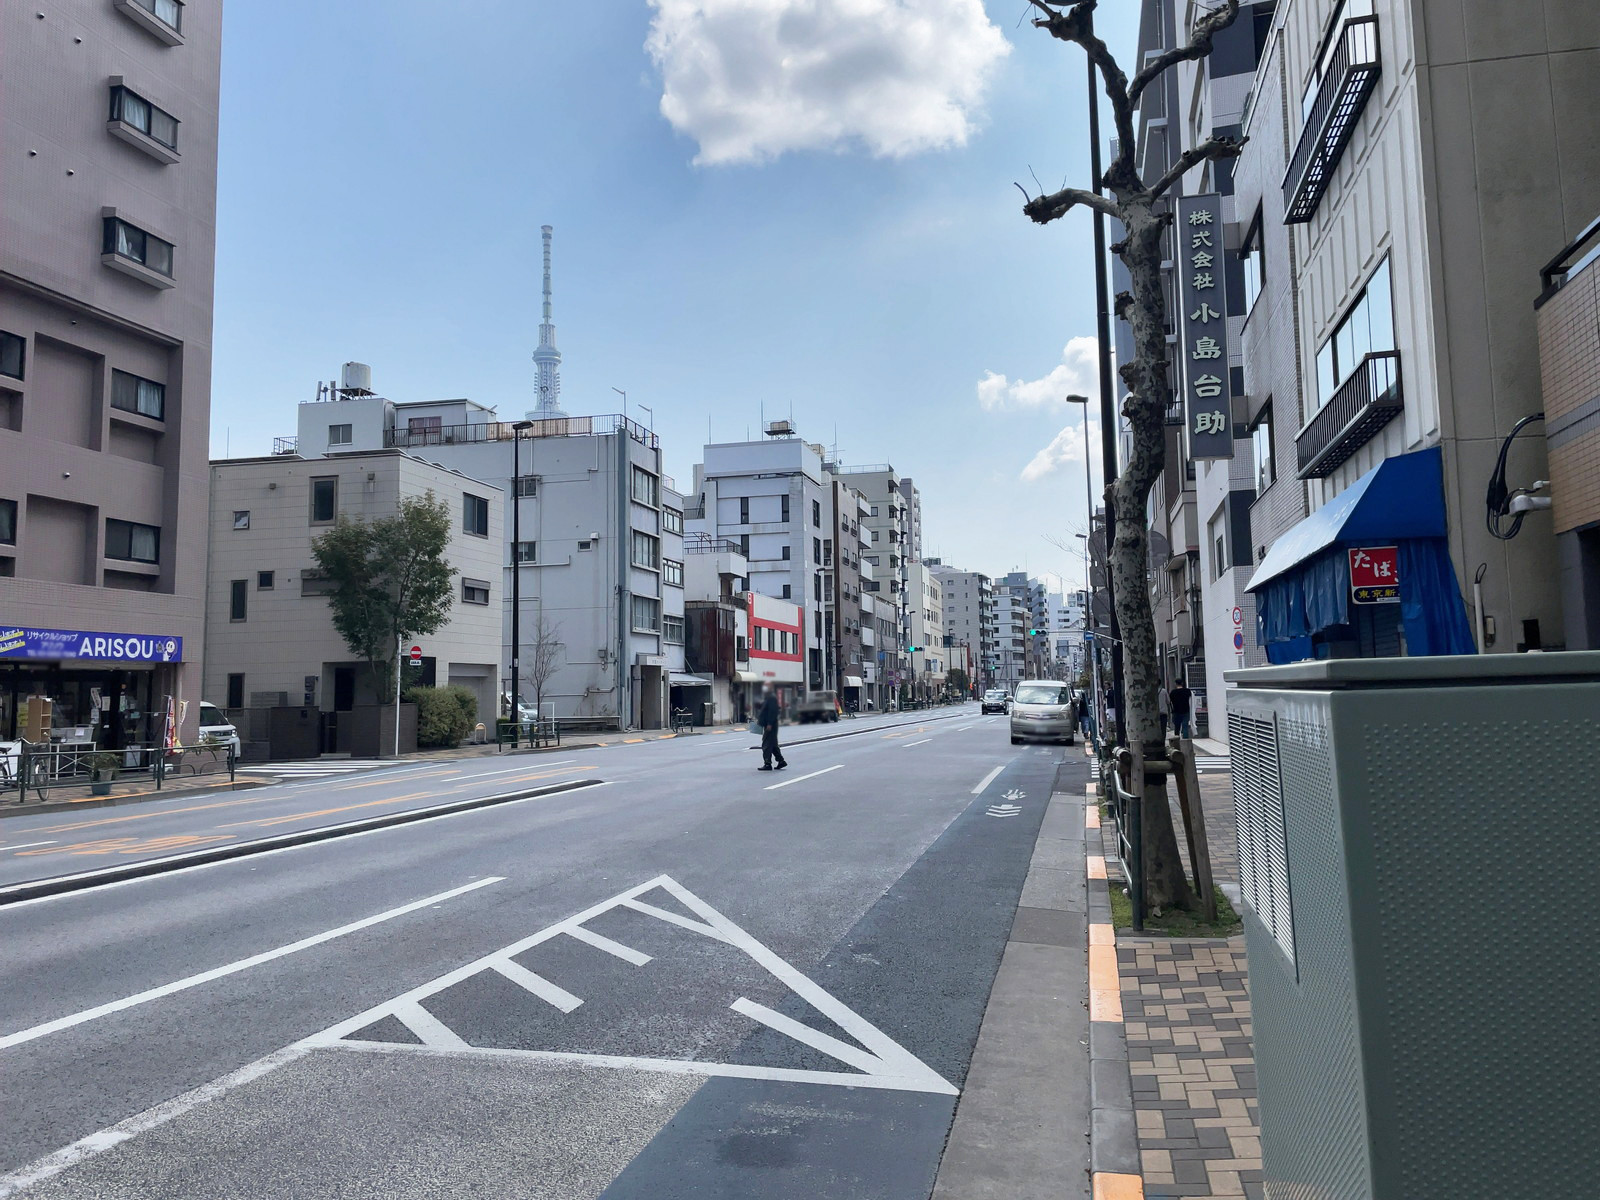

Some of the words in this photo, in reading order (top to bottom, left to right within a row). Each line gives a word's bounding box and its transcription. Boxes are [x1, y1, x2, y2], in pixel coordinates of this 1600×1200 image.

[1189, 210, 1226, 435] 株式会社小島台助
[1353, 551, 1399, 583] たば
[1358, 588, 1400, 599] 東京新
[27, 631, 79, 642] リサイクルショップ
[79, 637, 154, 658] ARISOU
